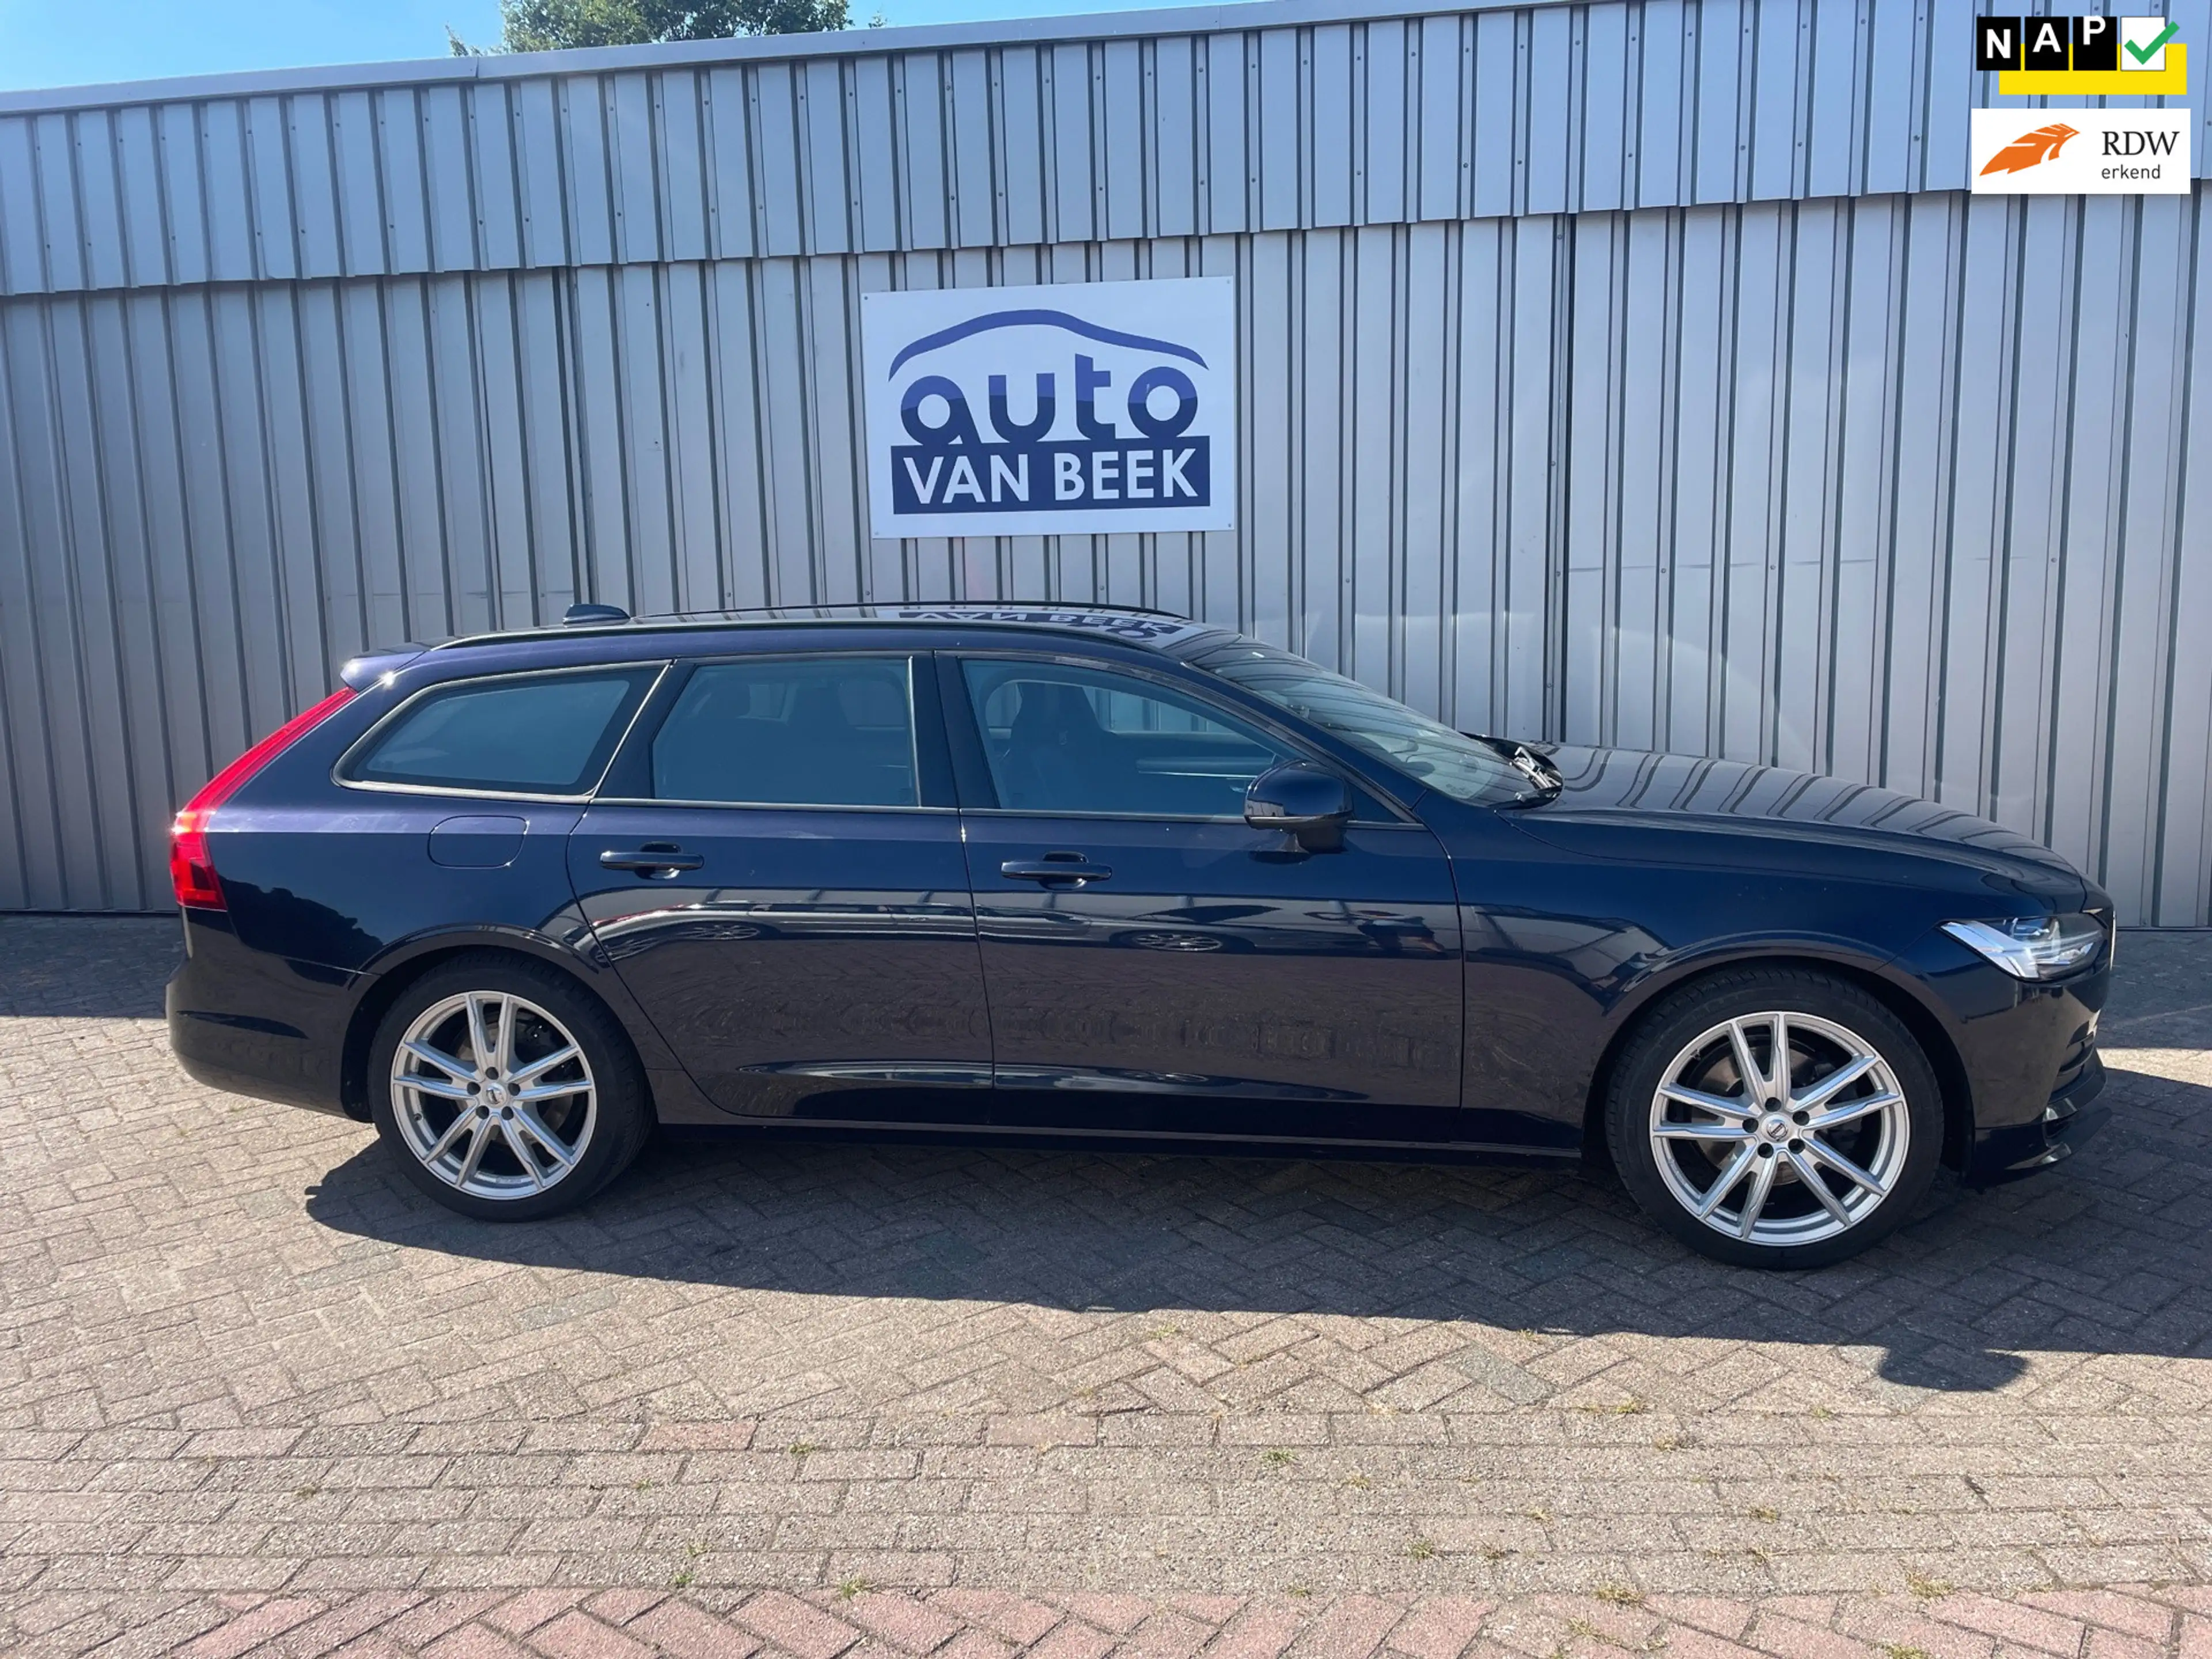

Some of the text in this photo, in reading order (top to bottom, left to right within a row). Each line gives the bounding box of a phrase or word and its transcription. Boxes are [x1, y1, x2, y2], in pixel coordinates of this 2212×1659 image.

[900, 353, 1198, 445] auto
[903, 448, 1198, 504] VAN BEEK
